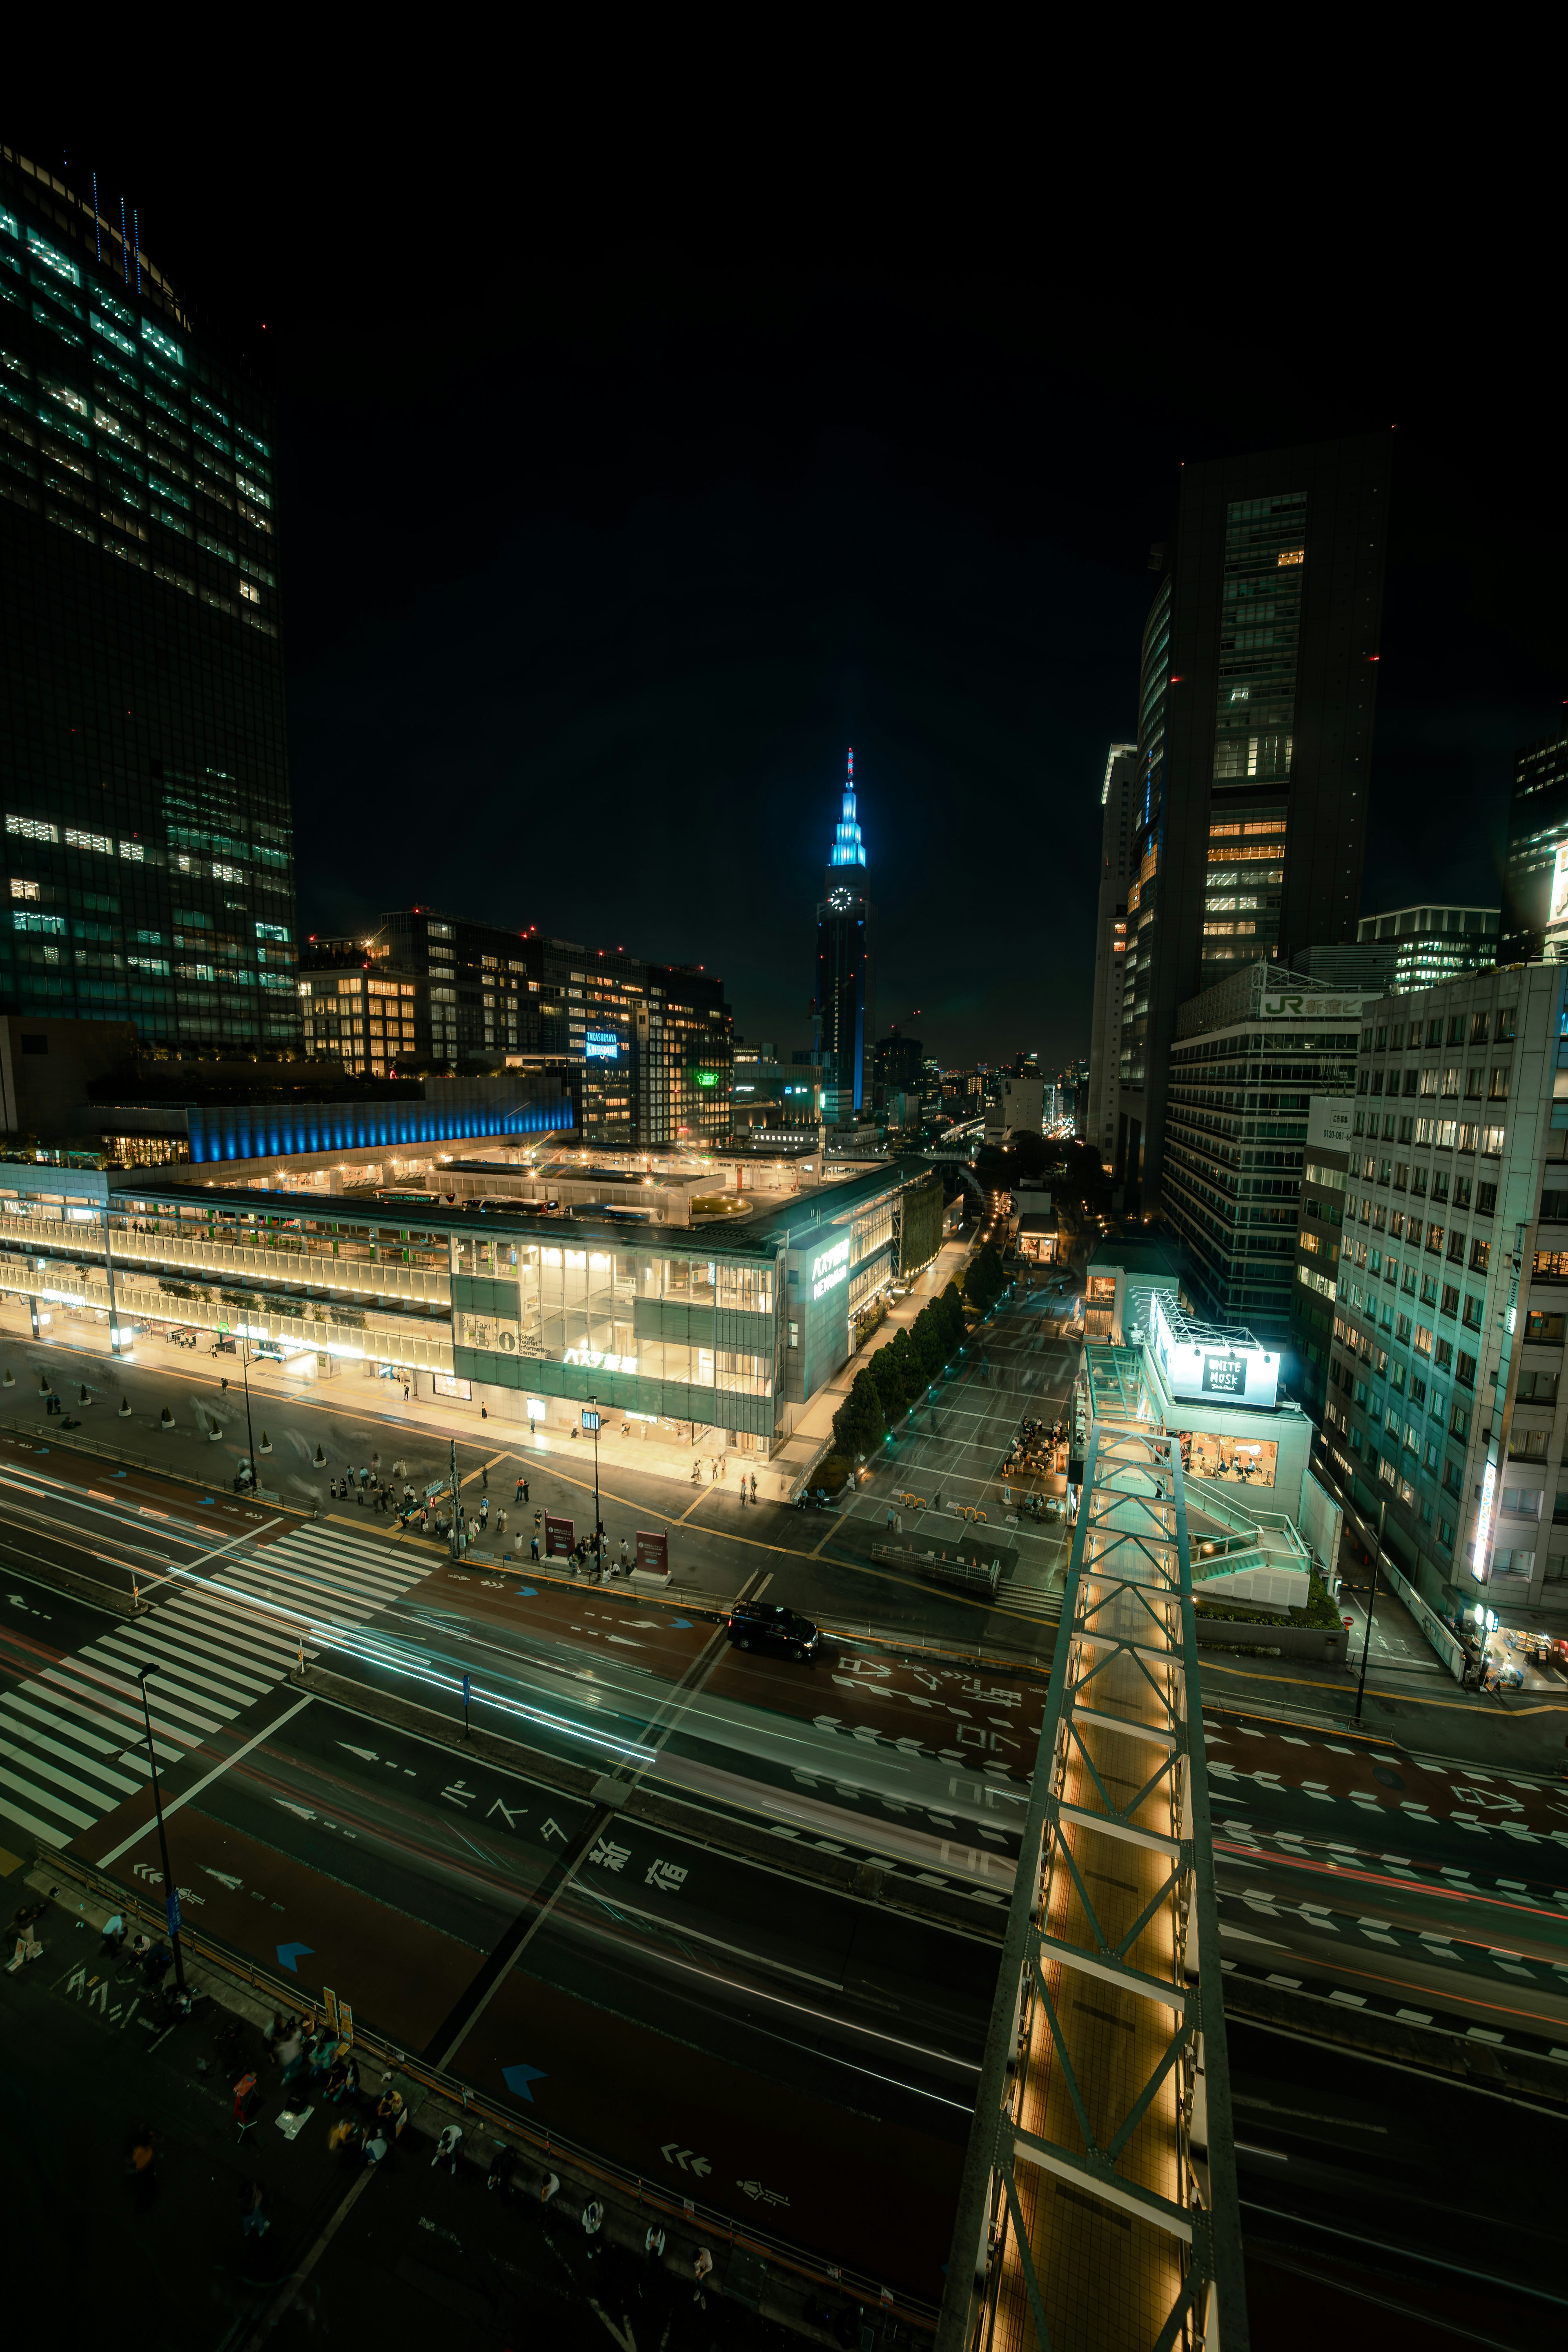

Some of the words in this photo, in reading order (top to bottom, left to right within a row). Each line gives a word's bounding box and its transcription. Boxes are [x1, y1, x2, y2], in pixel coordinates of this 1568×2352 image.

[1265, 996, 1303, 1014] JR
[587, 1031, 617, 1043] TAKASHIMAYA
[1333, 1115, 1348, 1124] 広告募集
[475, 1320, 490, 1330] Taxi
[519, 1333, 535, 1341] Tokyo
[519, 1344, 551, 1354] Information
[1209, 1359, 1241, 1372] WHITE
[1210, 1372, 1238, 1385] MUSK
